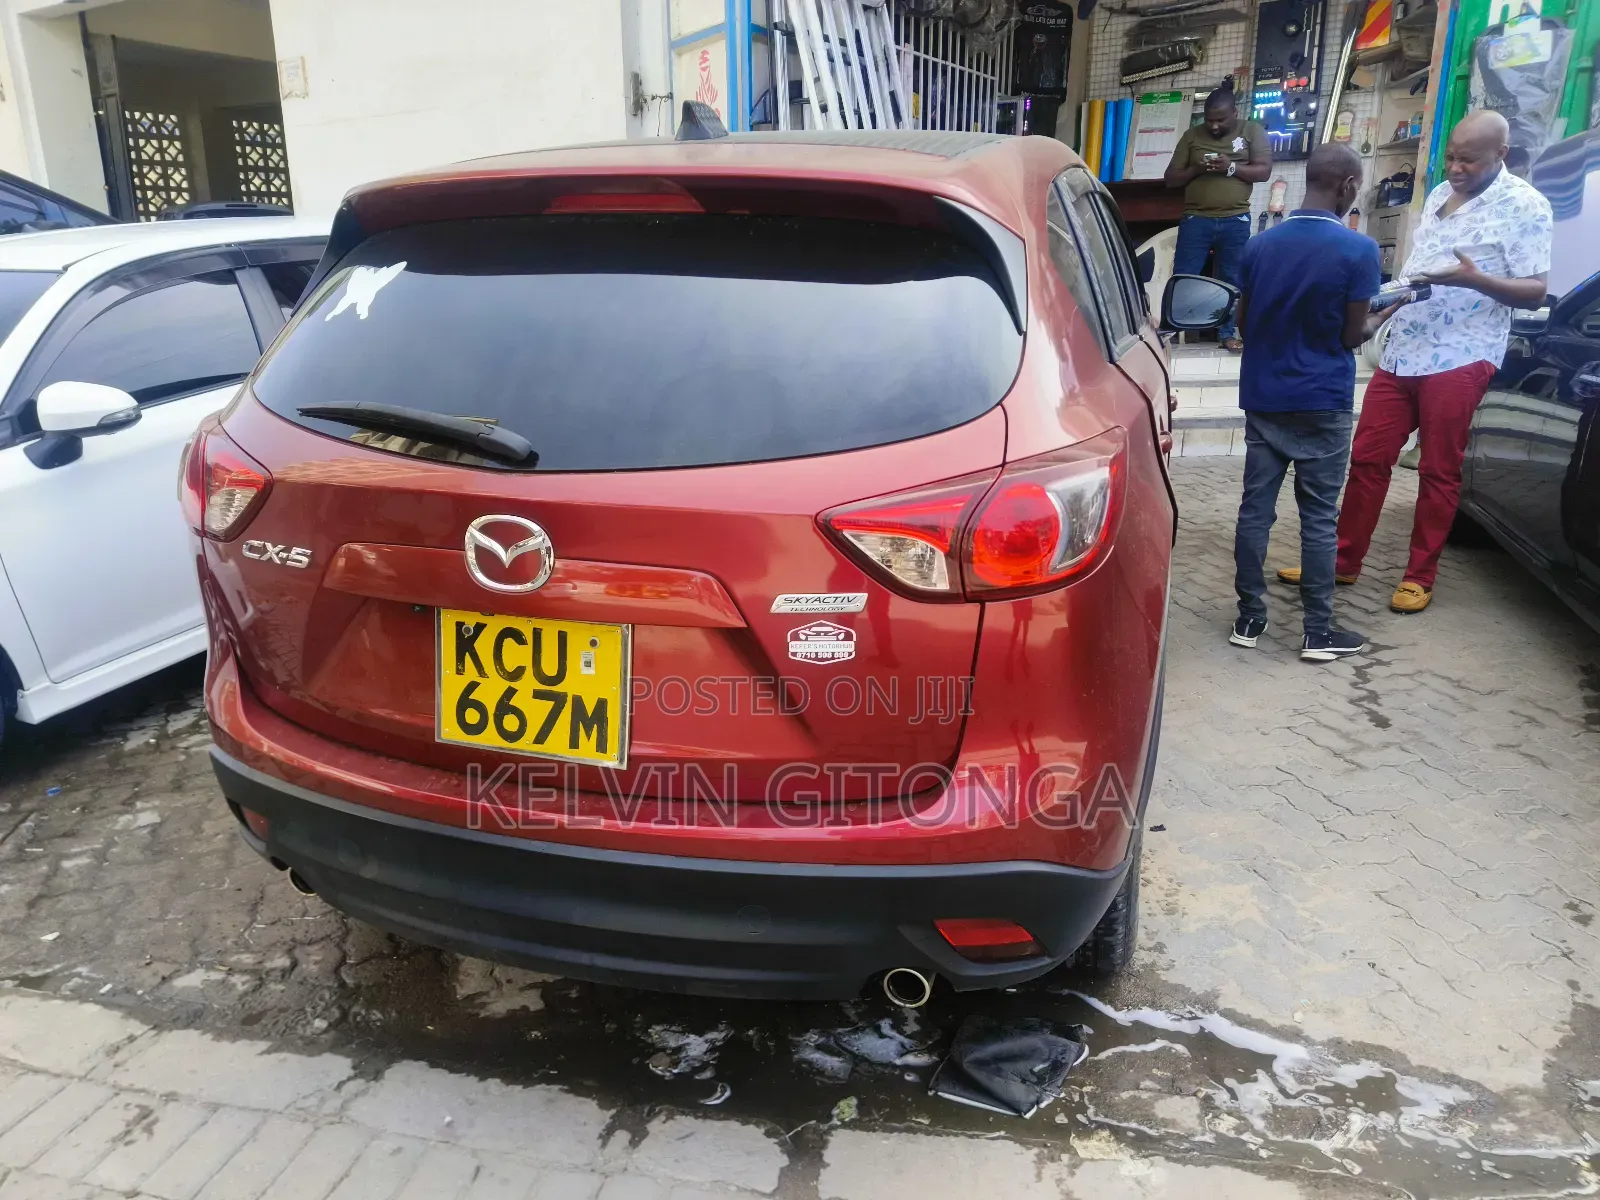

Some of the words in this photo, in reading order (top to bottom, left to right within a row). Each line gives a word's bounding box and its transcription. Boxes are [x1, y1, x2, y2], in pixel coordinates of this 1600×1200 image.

[242, 539, 313, 569] CX-5
[783, 596, 857, 604] SKYACTIV
[454, 620, 569, 687] KCU
[455, 681, 609, 754] 667M
